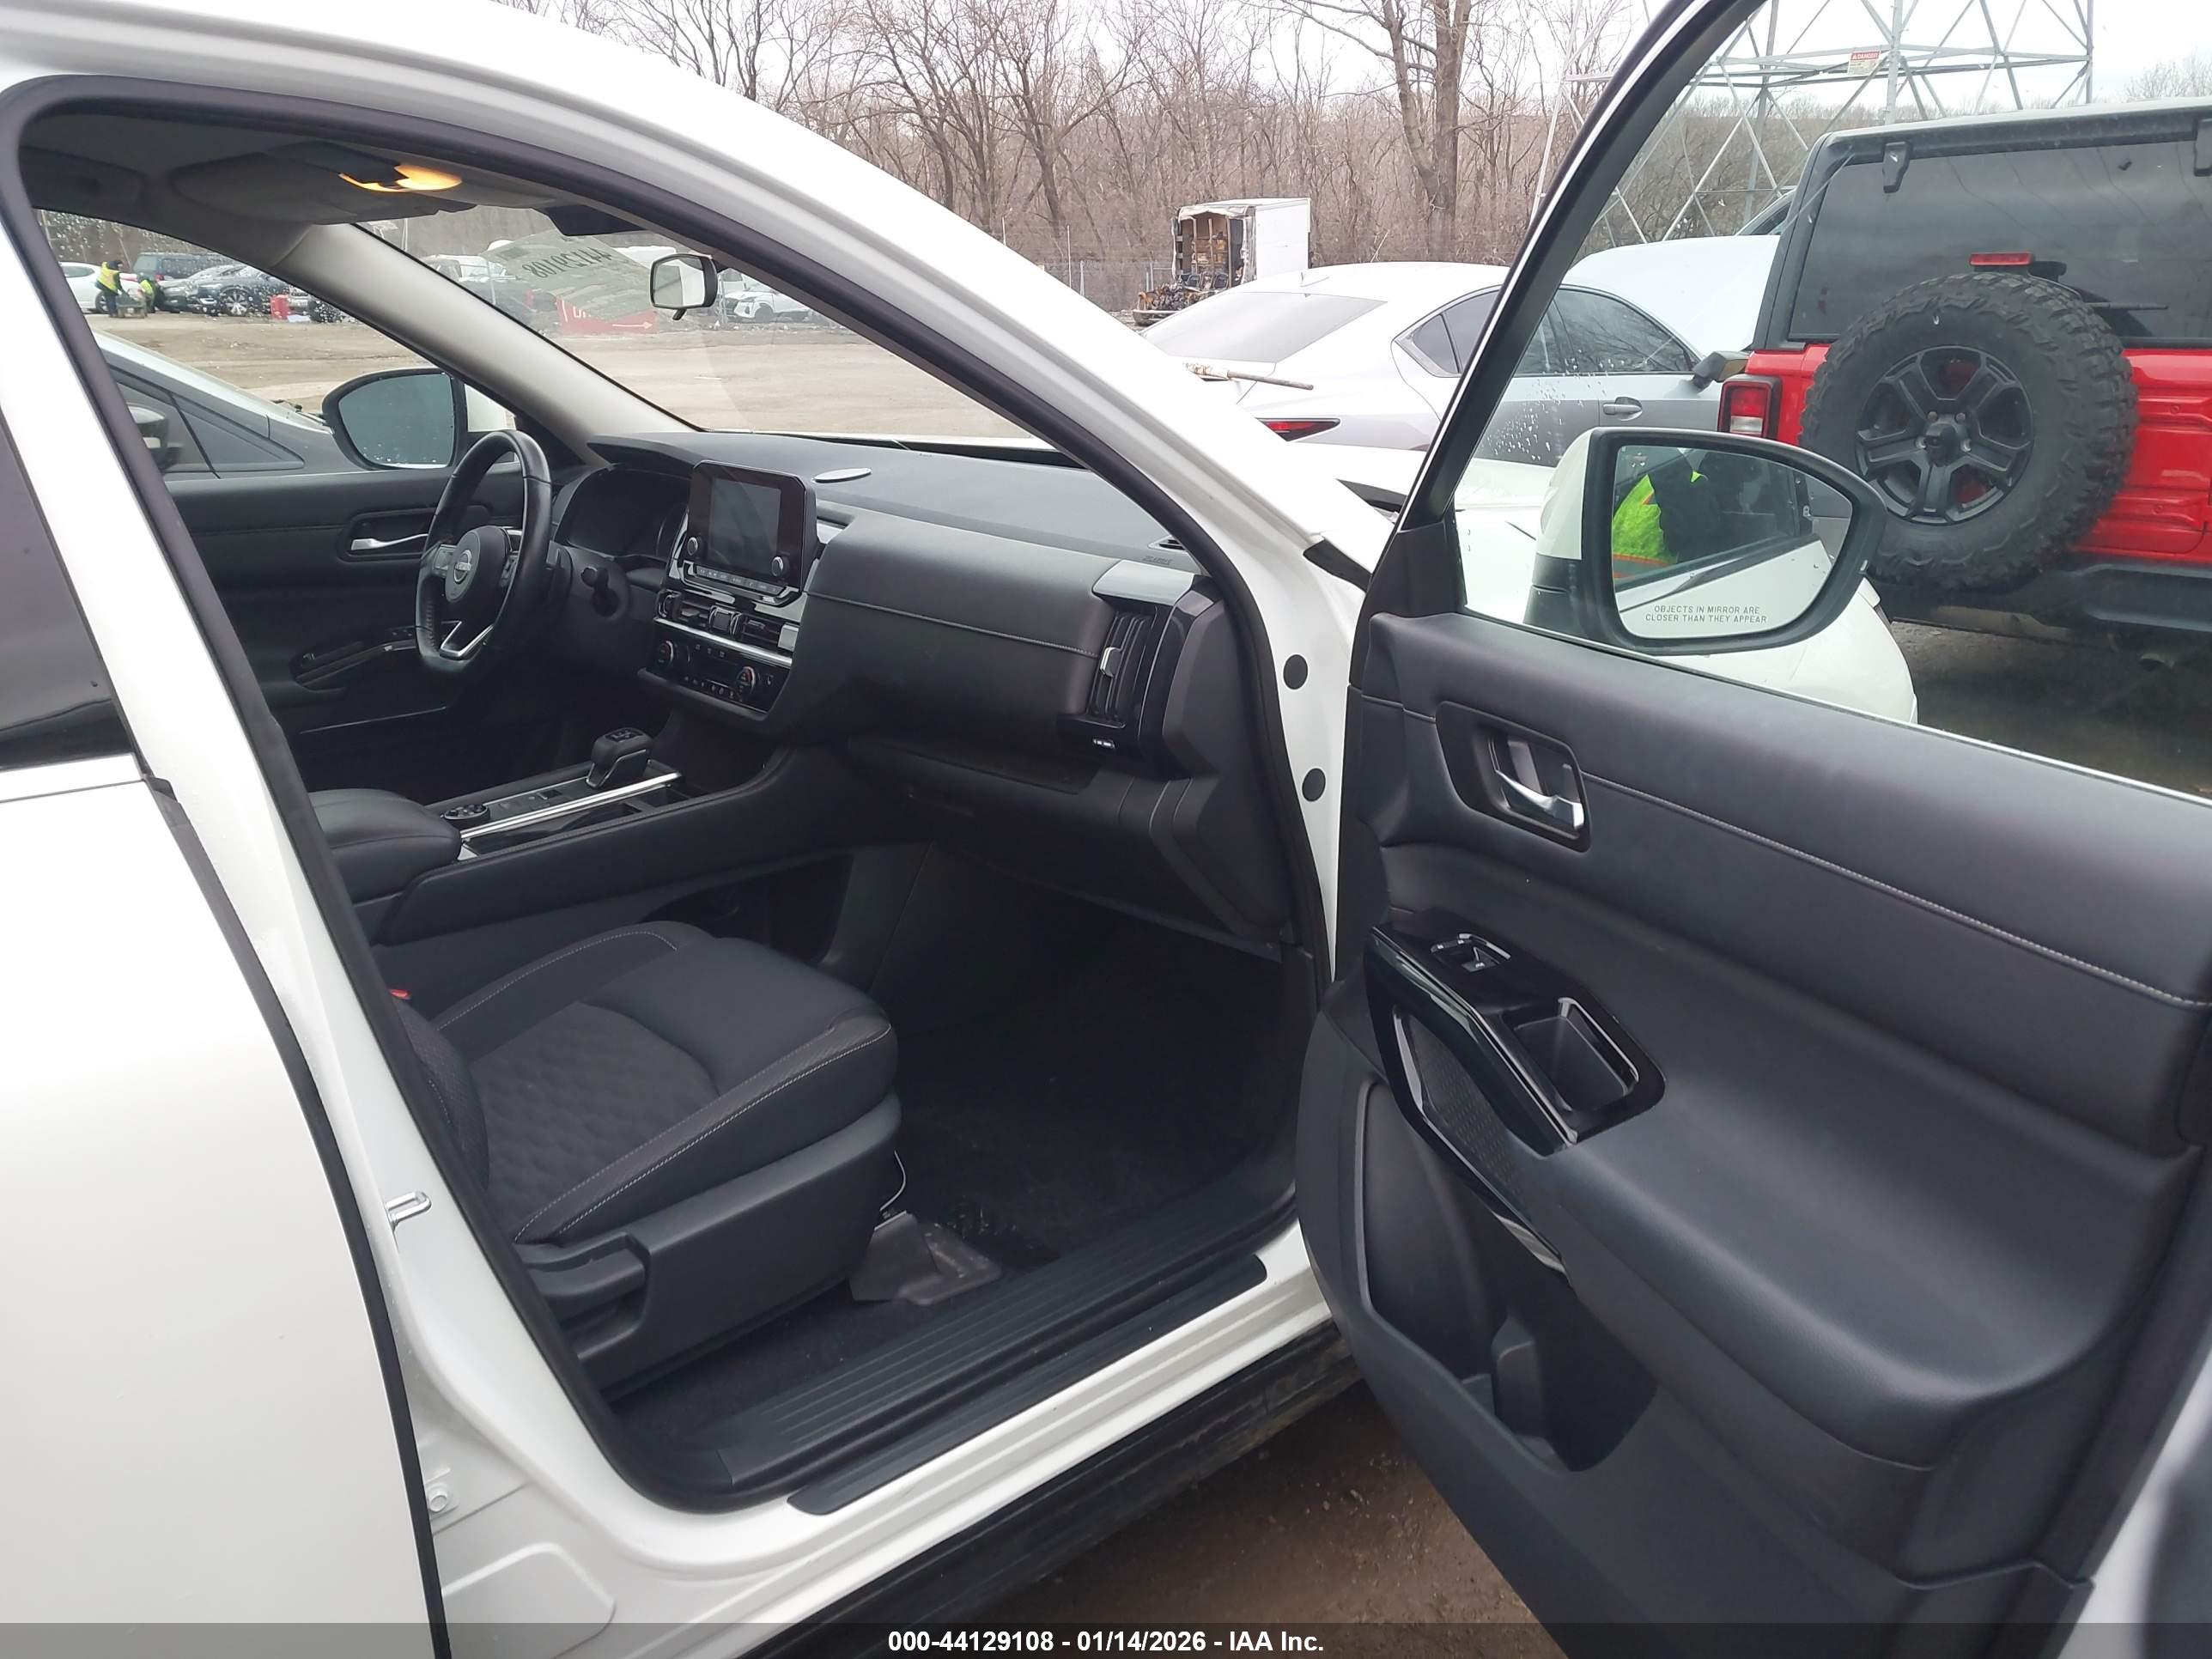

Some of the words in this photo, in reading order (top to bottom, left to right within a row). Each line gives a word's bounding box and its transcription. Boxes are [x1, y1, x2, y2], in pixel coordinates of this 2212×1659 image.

[1707, 605, 1740, 614] MIRROR
[1682, 614, 1705, 623] THAN
[1708, 615, 1731, 623] THEY
[1734, 616, 1767, 624] APPEAR
